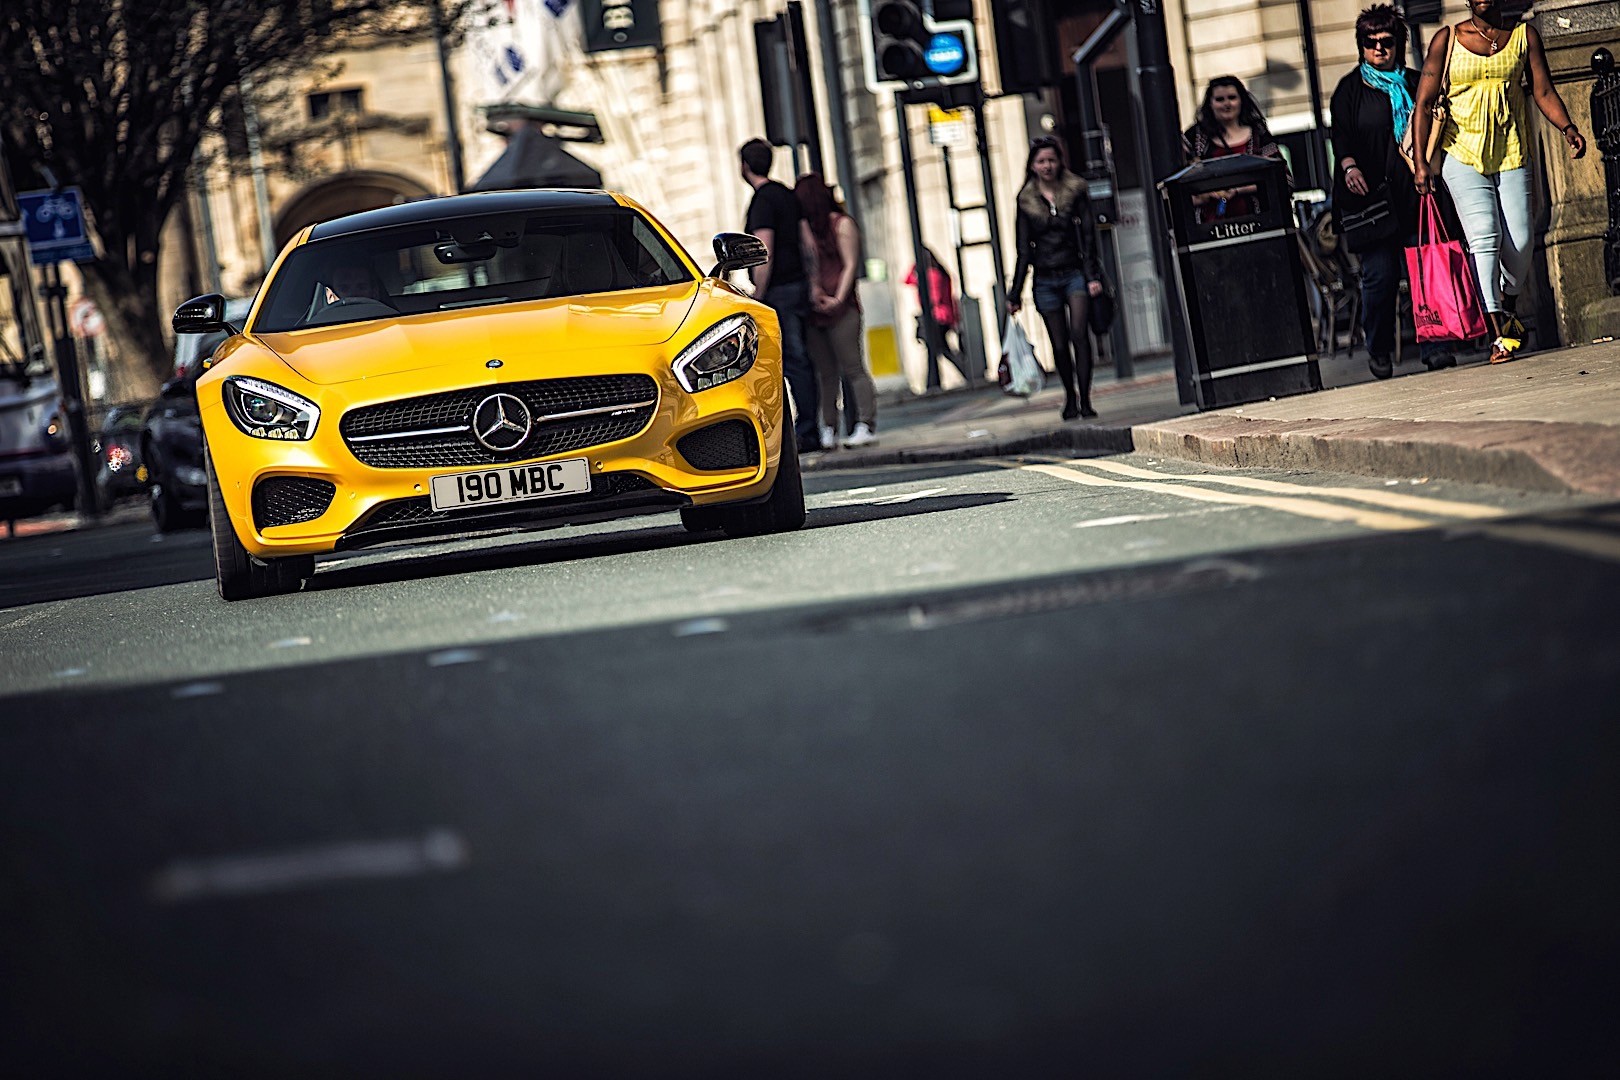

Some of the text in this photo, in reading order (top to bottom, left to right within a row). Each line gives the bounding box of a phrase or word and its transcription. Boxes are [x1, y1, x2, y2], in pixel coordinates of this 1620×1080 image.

[1215, 222, 1256, 239] Litter
[457, 464, 565, 503] 190 MBC
